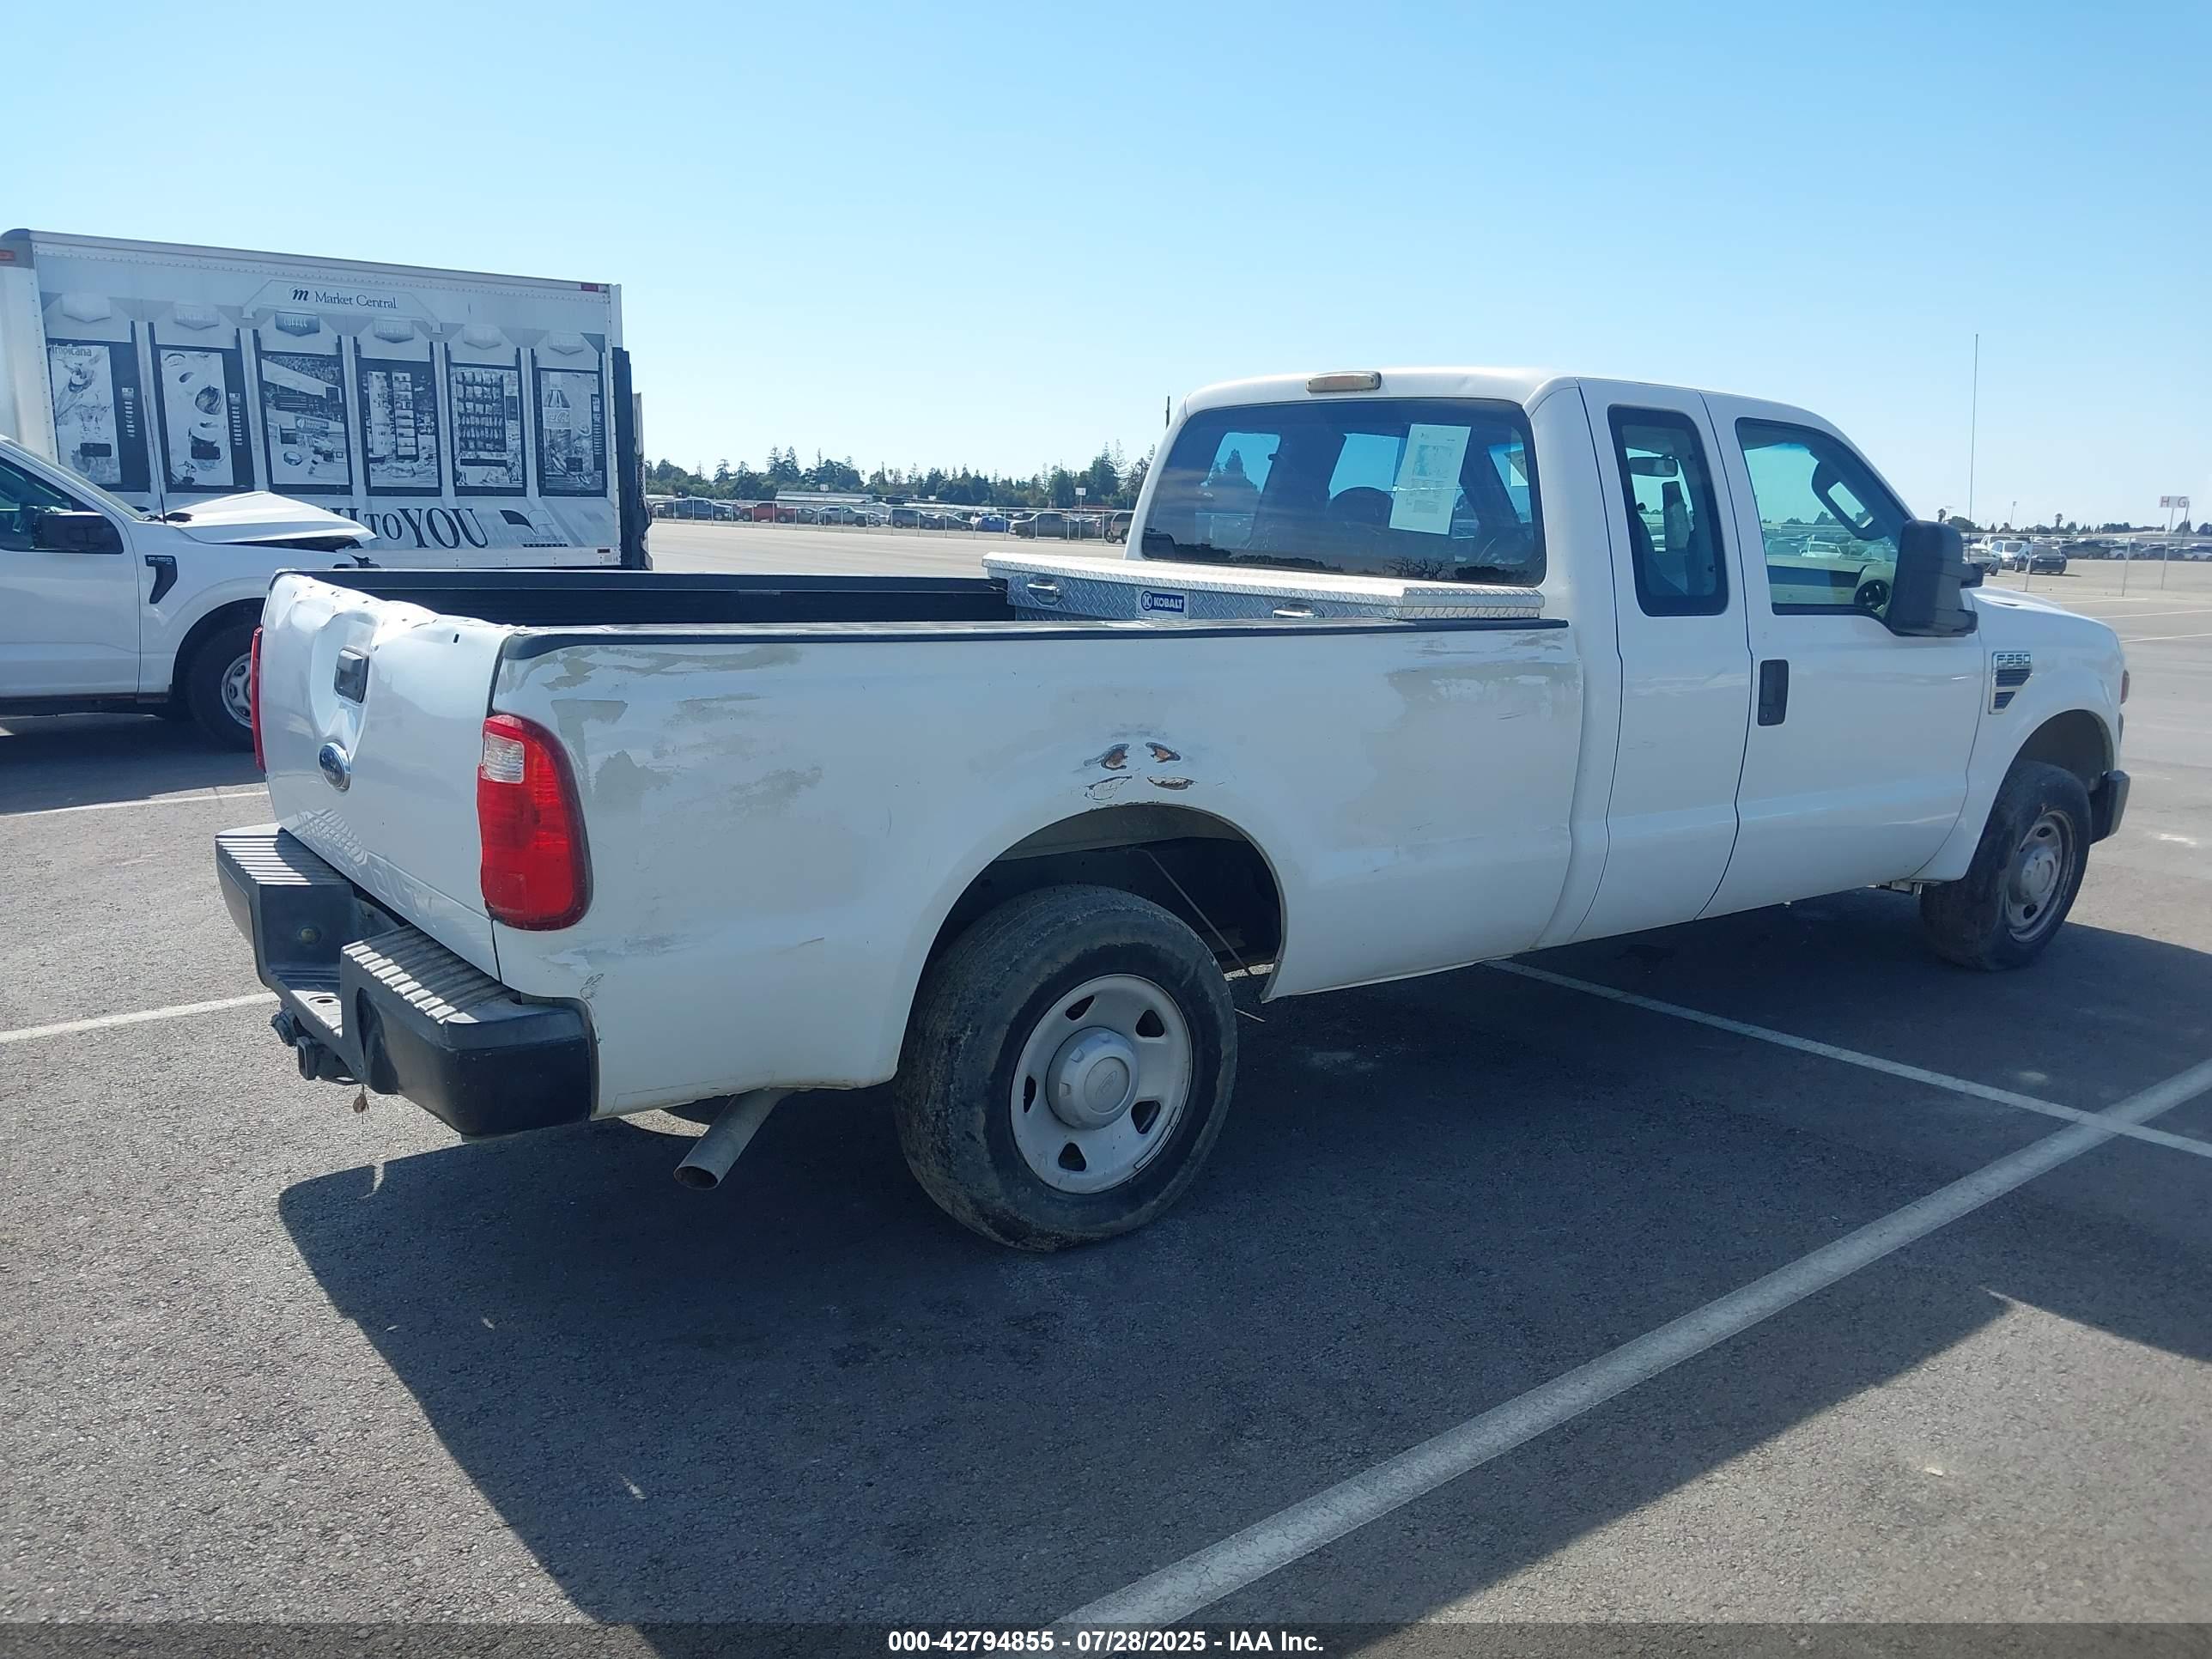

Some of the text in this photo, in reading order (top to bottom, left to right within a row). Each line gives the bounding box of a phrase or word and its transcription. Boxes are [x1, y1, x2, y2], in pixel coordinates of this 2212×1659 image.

[314, 290, 354, 306] Market
[356, 295, 398, 309] Central
[397, 507, 489, 549] YOU
[1153, 596, 1183, 610] KOBALT
[1996, 653, 2032, 665] F-250
